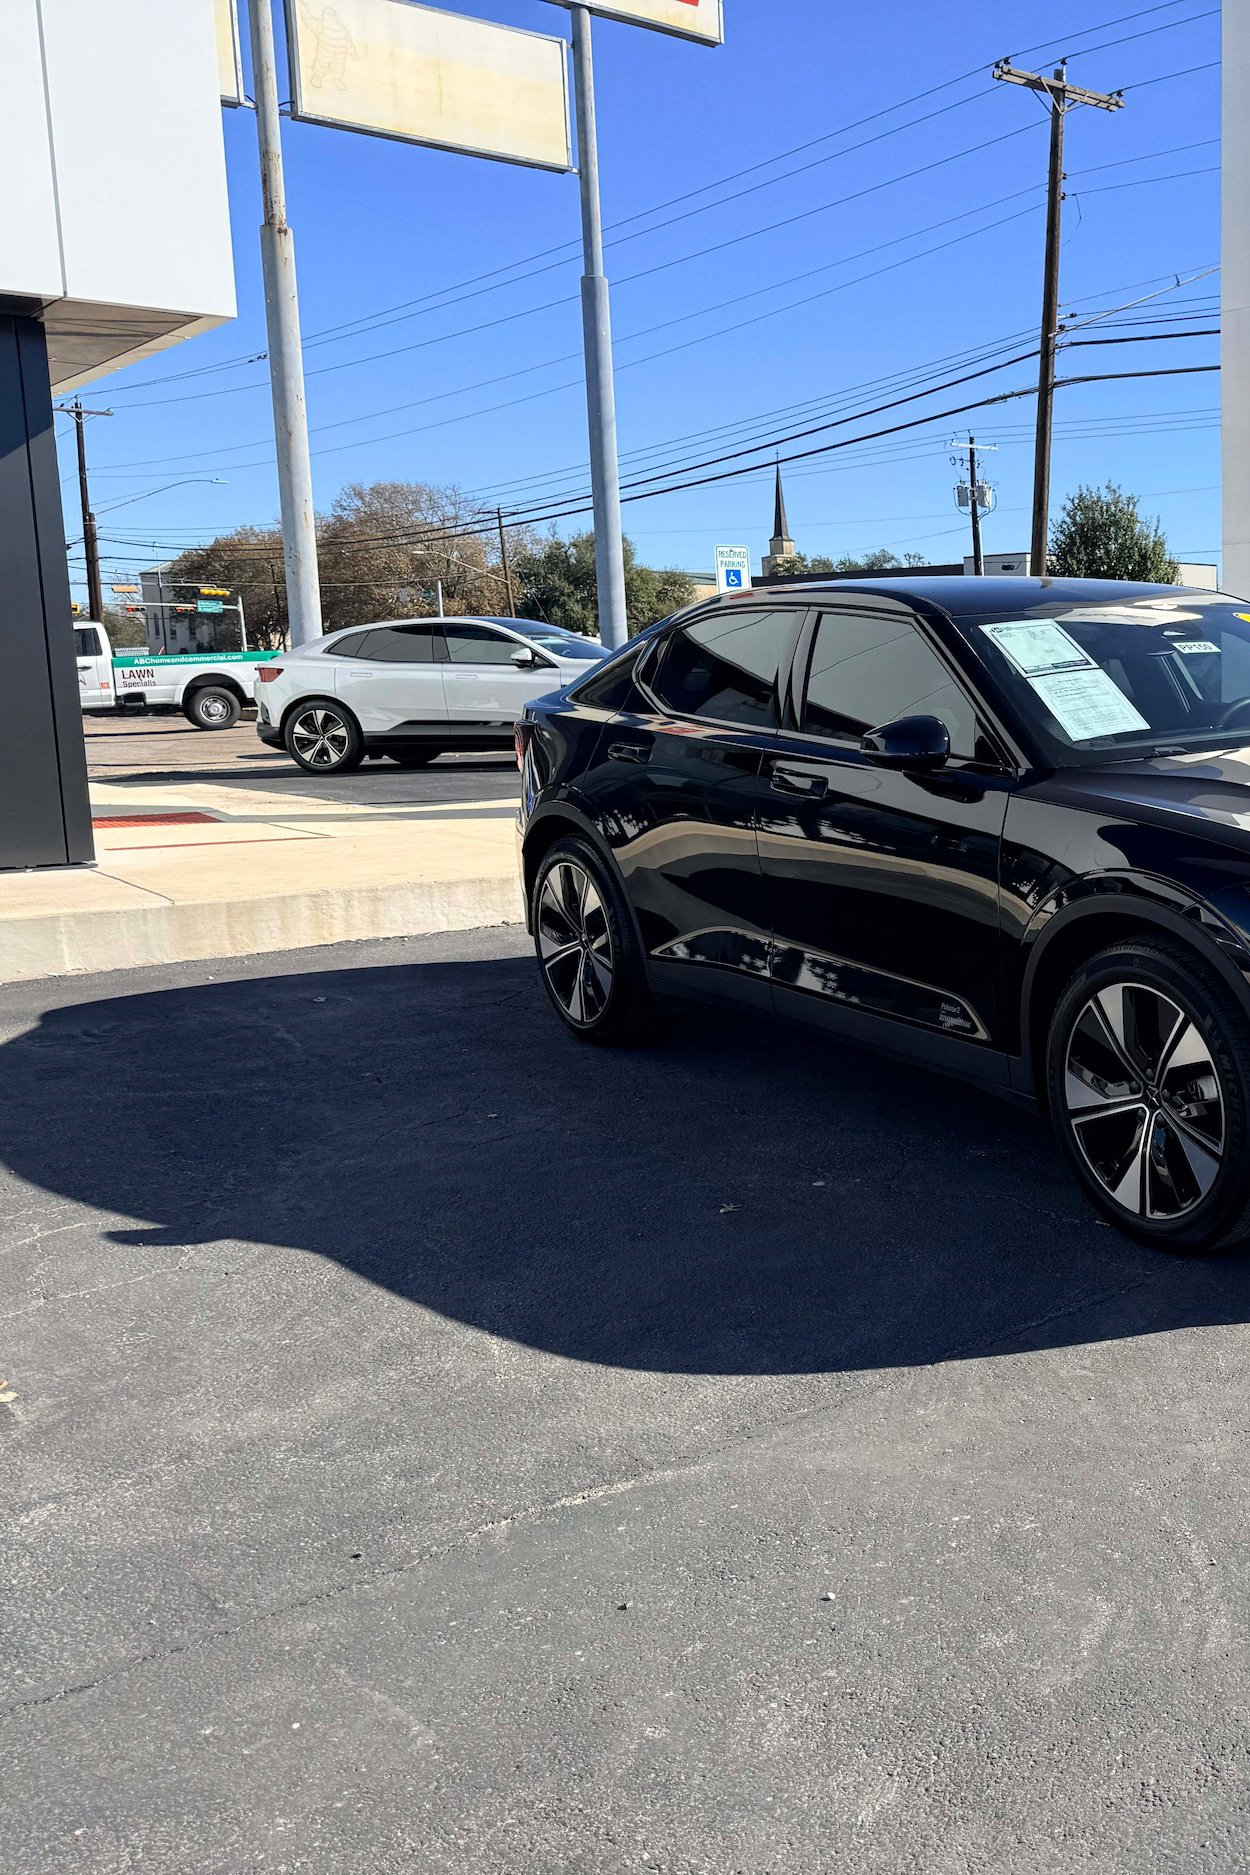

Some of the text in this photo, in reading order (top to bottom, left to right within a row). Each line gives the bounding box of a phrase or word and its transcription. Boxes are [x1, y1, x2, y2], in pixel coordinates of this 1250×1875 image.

[718, 550, 746, 559] RESERVED
[720, 560, 746, 568] PARKING
[122, 669, 155, 680] LAWN
